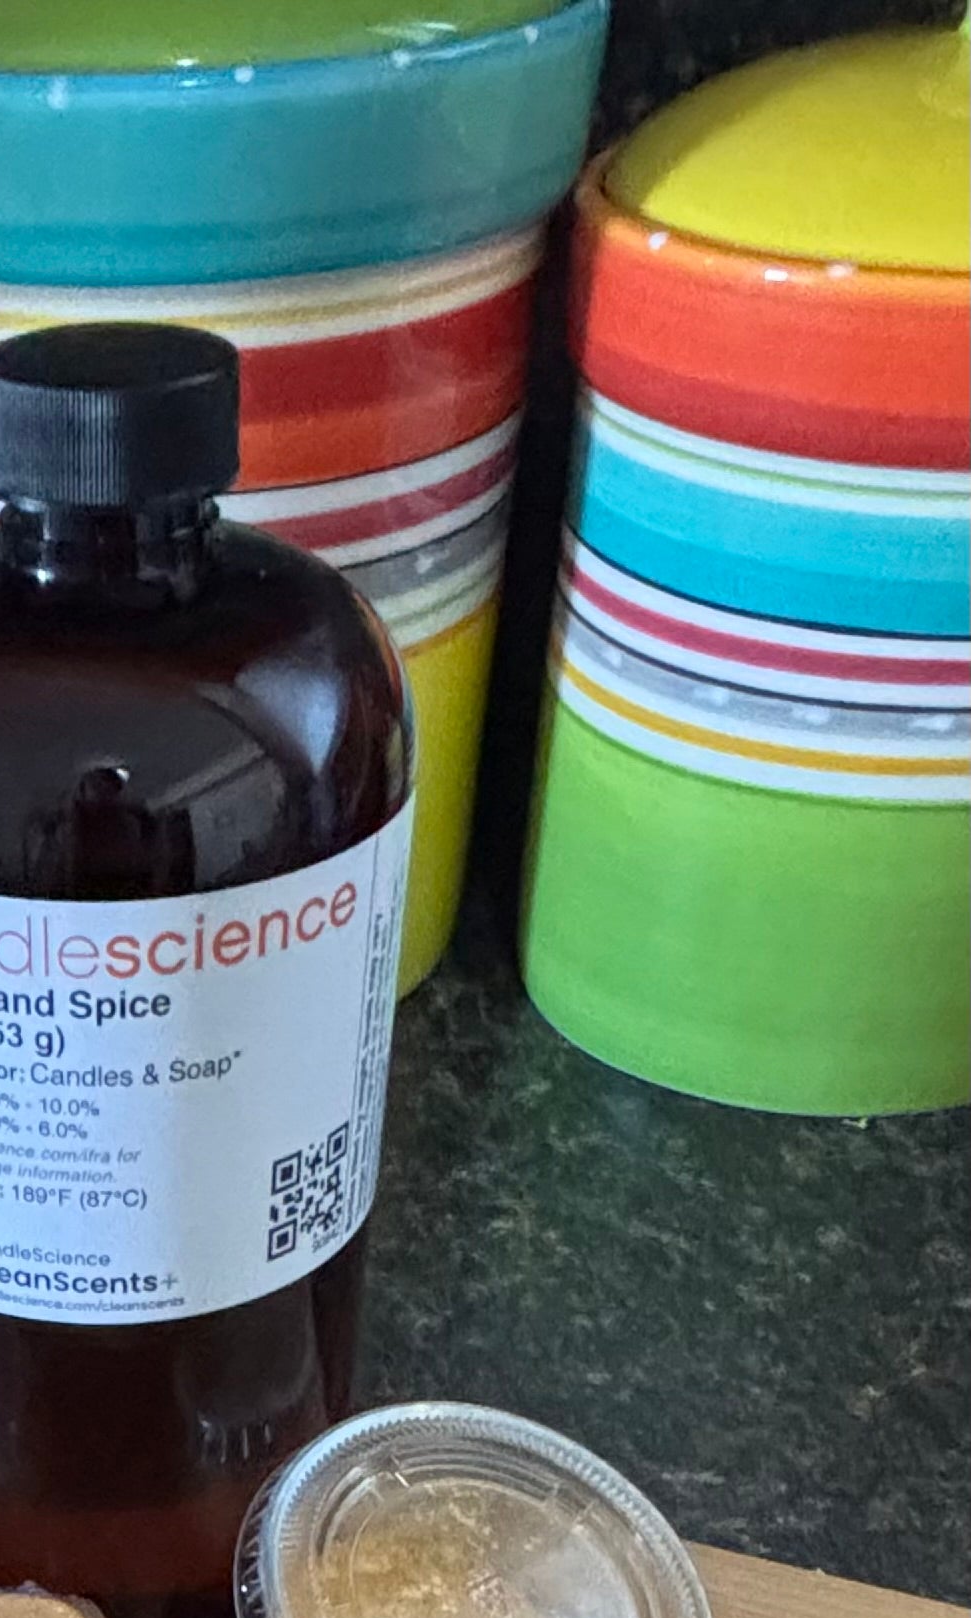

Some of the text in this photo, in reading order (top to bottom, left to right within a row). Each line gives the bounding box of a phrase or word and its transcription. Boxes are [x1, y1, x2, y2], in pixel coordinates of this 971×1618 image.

[68, 988, 172, 1027] Spice
[33, 1024, 66, 1059] g)
[30, 1061, 134, 1088] Candles
[141, 1062, 160, 1086] &
[39, 1097, 101, 1117] 10.0%
[116, 1145, 142, 1164] for
